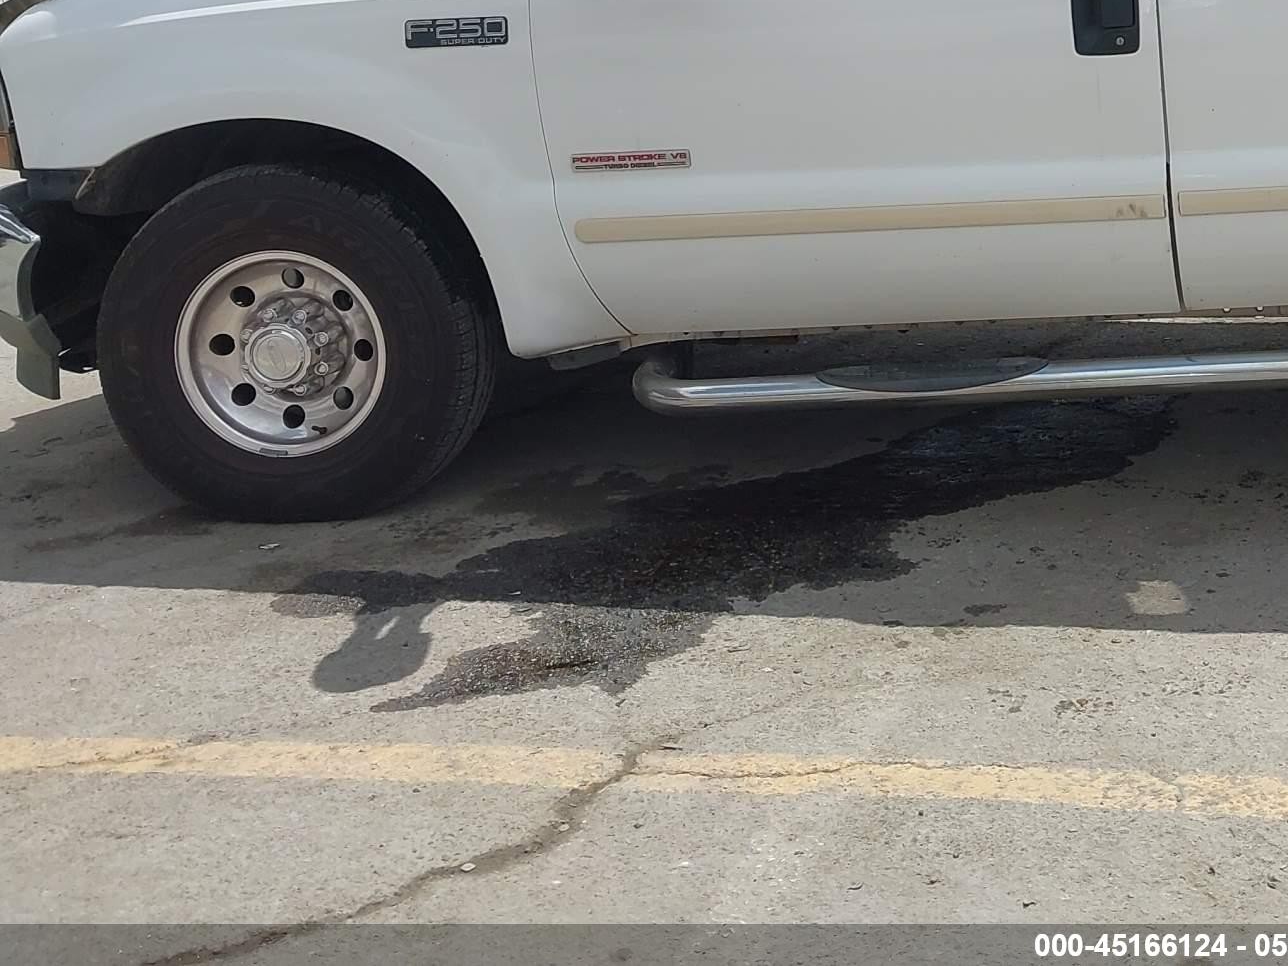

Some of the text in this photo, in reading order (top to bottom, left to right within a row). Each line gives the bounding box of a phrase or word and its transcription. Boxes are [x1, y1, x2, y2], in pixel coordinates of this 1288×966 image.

[440, 36, 506, 46] SUPER DUTY
[572, 155, 615, 164] POWER
[618, 153, 666, 162] STROKE
[630, 161, 657, 169] DIESEL
